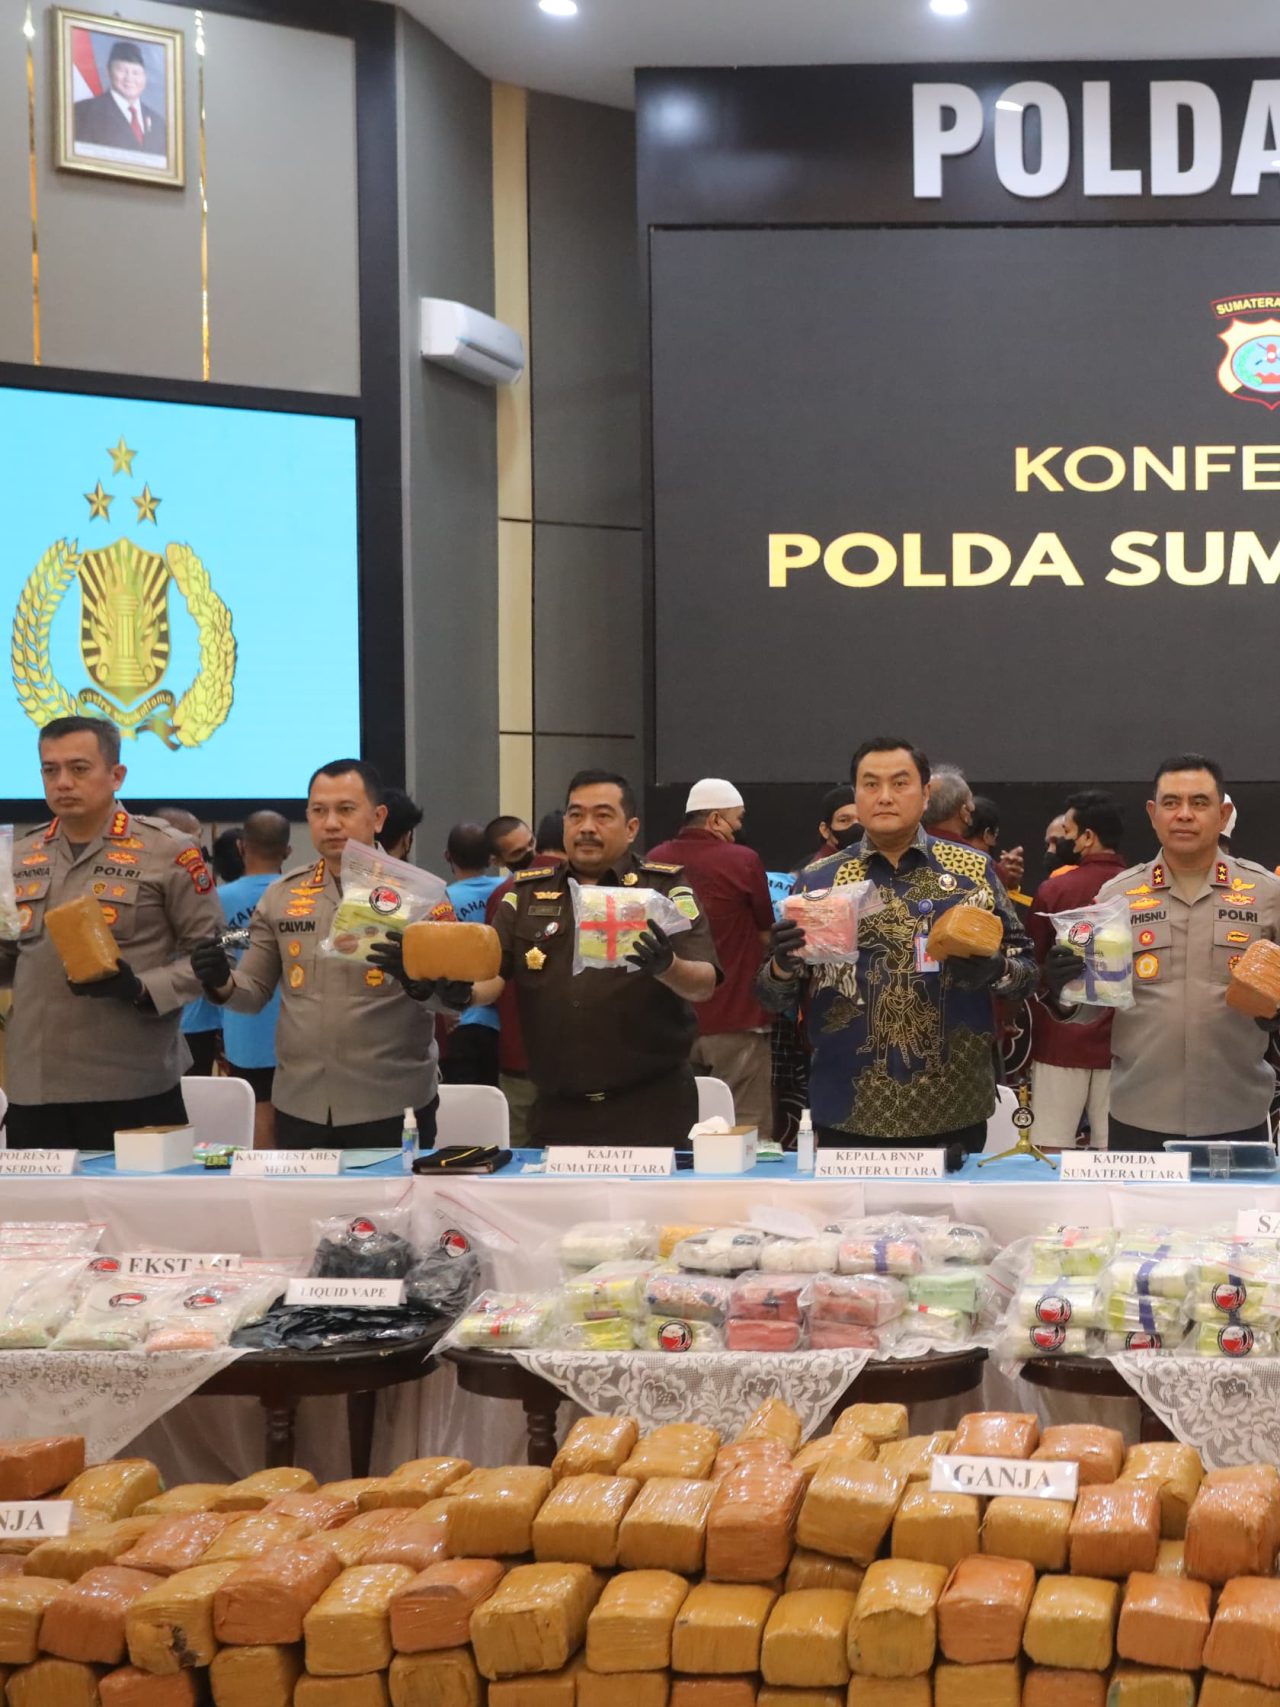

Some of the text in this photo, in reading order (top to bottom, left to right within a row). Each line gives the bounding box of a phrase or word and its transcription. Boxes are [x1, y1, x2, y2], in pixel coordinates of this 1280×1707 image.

[768, 532, 1084, 587] POLDA
[93, 866, 141, 879] POLRI
[1218, 908, 1258, 923] POLRI
[235, 1150, 338, 1161] KAPOLRESTABES
[586, 1149, 633, 1159] KAJATI
[836, 1152, 924, 1161] KEPALA BNNP
[1093, 1154, 1156, 1164] KAPOLDA
[6, 1165, 61, 1174] SERDANG
[264, 1165, 308, 1174] MEDAN
[549, 1163, 666, 1174] SUMATERA UTARA
[819, 1166, 938, 1176] SUMATERA UTARA
[1063, 1168, 1184, 1179] SUMATERA UTARA
[300, 1287, 388, 1298] LIQUID VAPE
[953, 1463, 1052, 1490] GANJA
